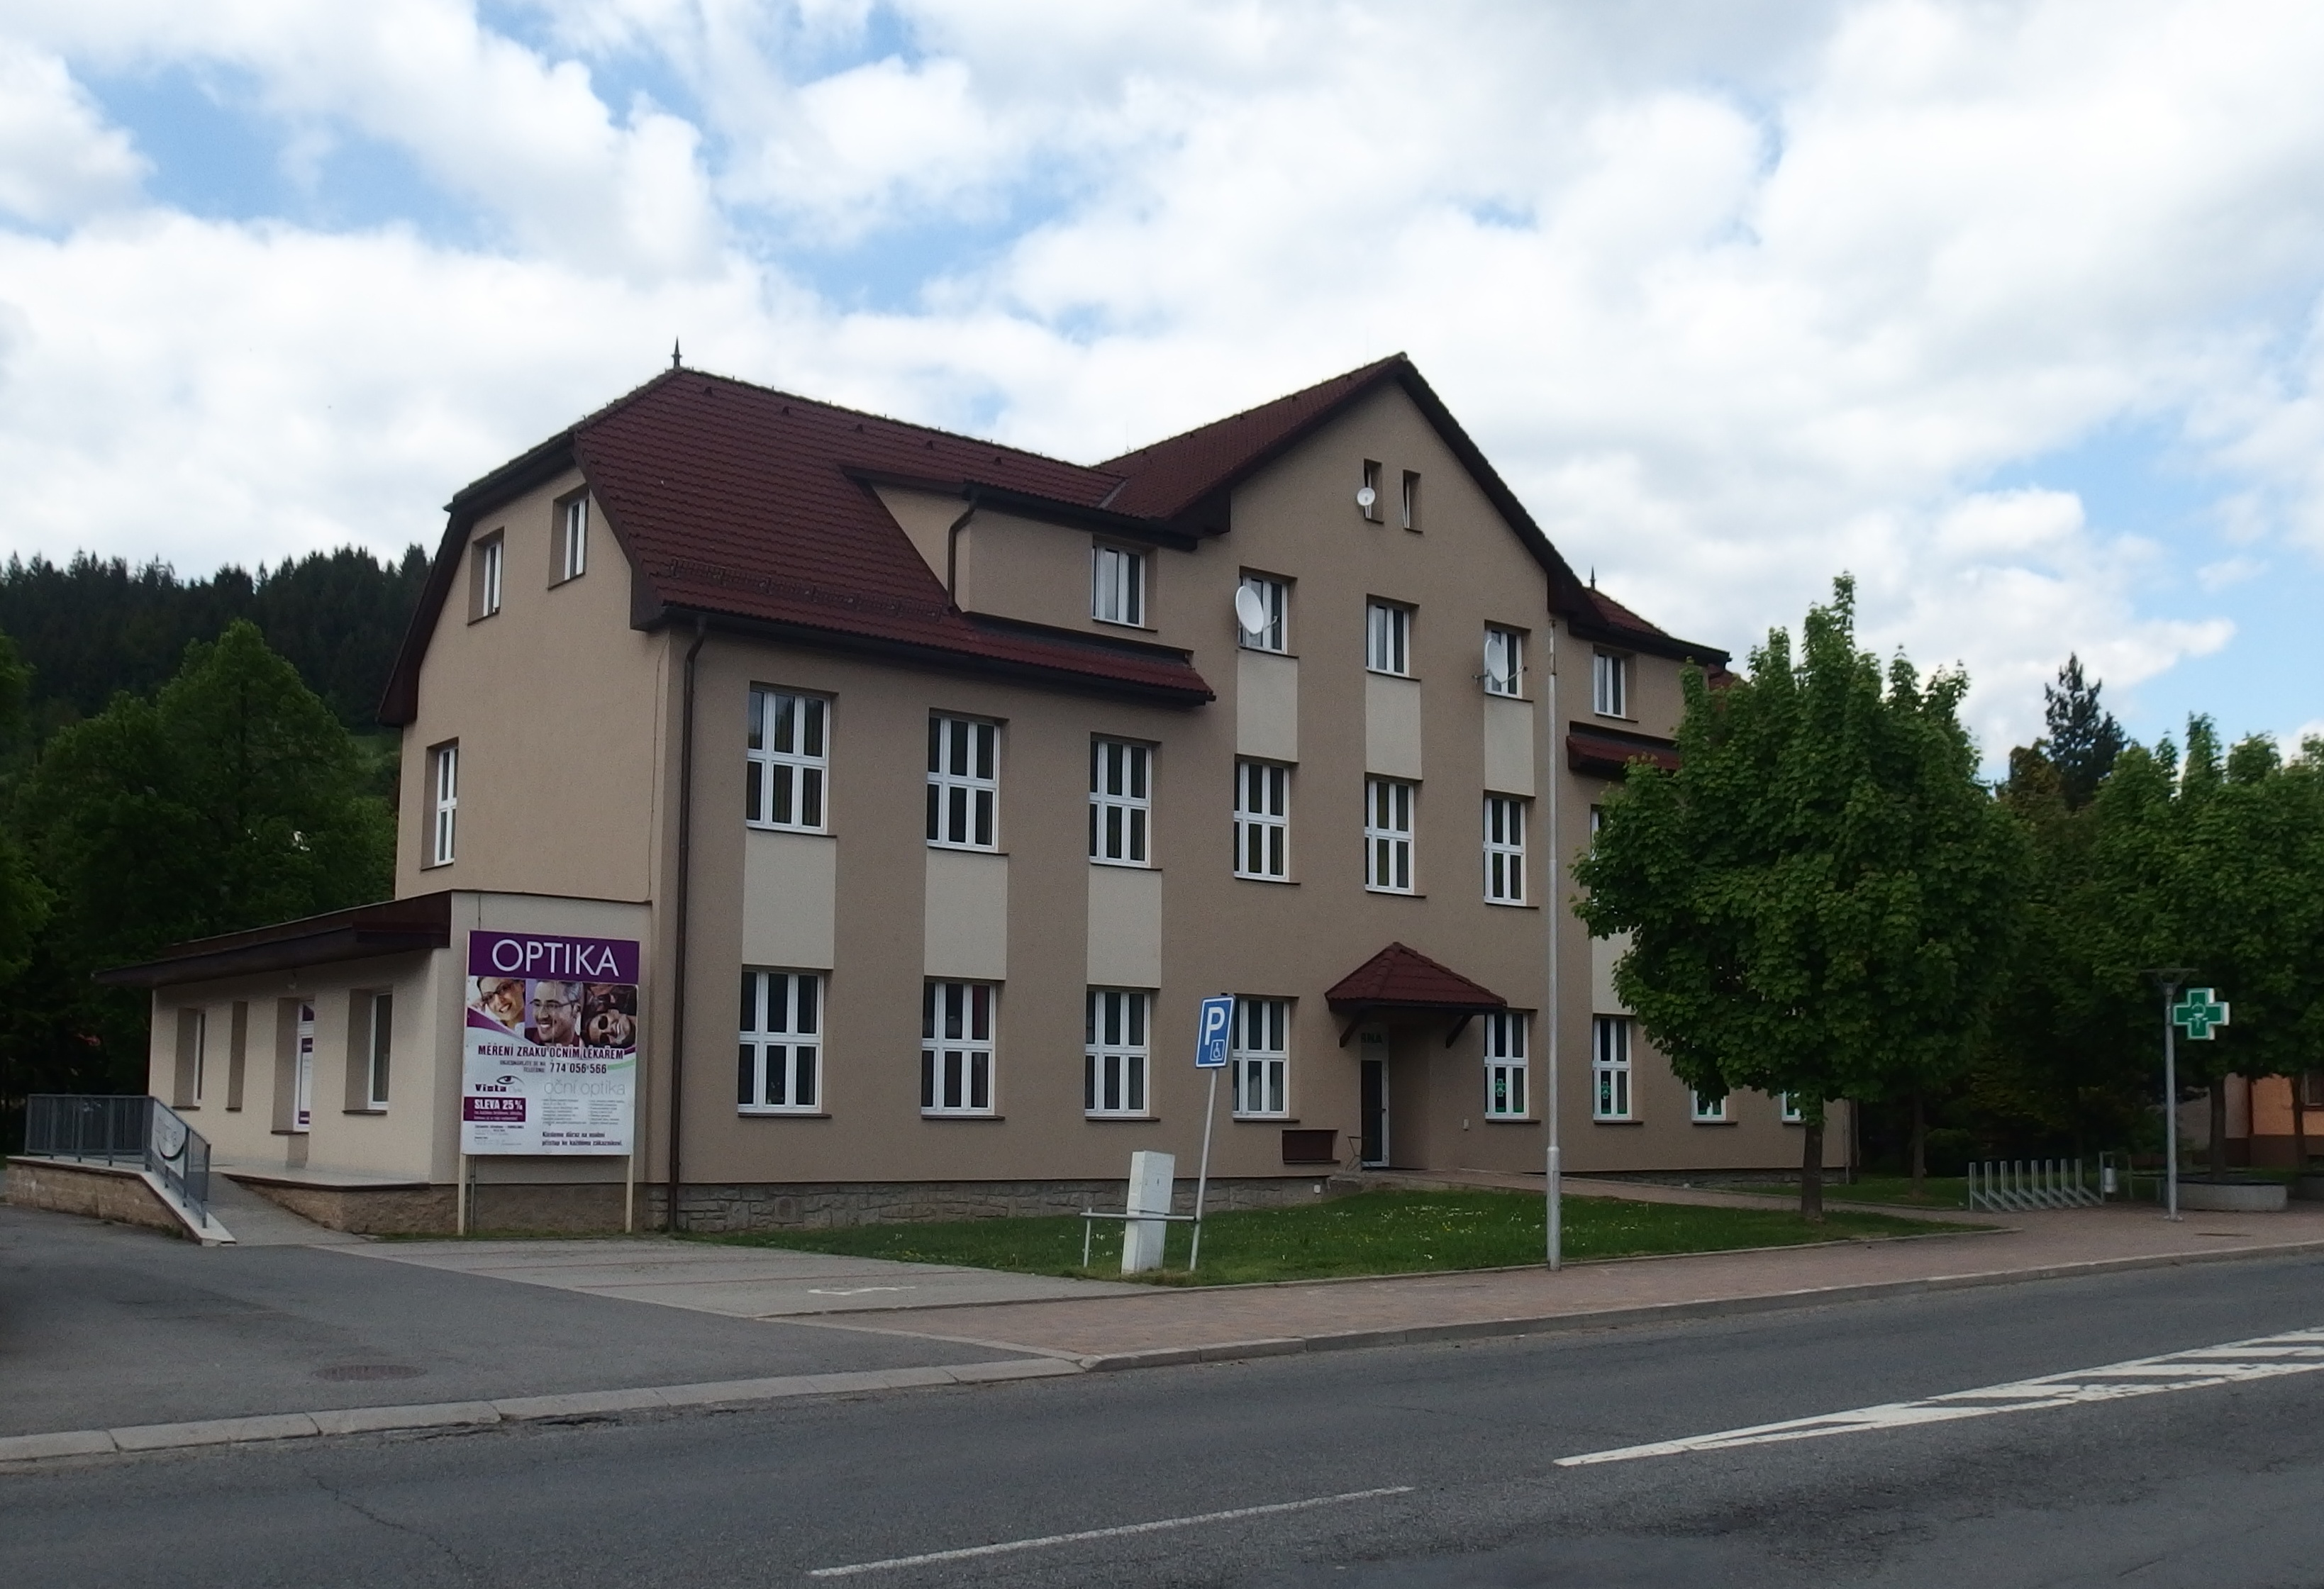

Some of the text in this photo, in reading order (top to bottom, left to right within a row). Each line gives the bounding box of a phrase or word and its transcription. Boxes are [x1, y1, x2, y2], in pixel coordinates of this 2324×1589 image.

[492, 939, 620, 976] OPTIKA
[1204, 1006, 1225, 1046] P
[478, 1042, 623, 1059] MĚŘENÍ ZRAKU OČNÍM LÉKAŘEM
[550, 1062, 607, 1074] 774 056 566
[544, 1079, 626, 1097] oční optika
[474, 1099, 500, 1110] SLEVA
